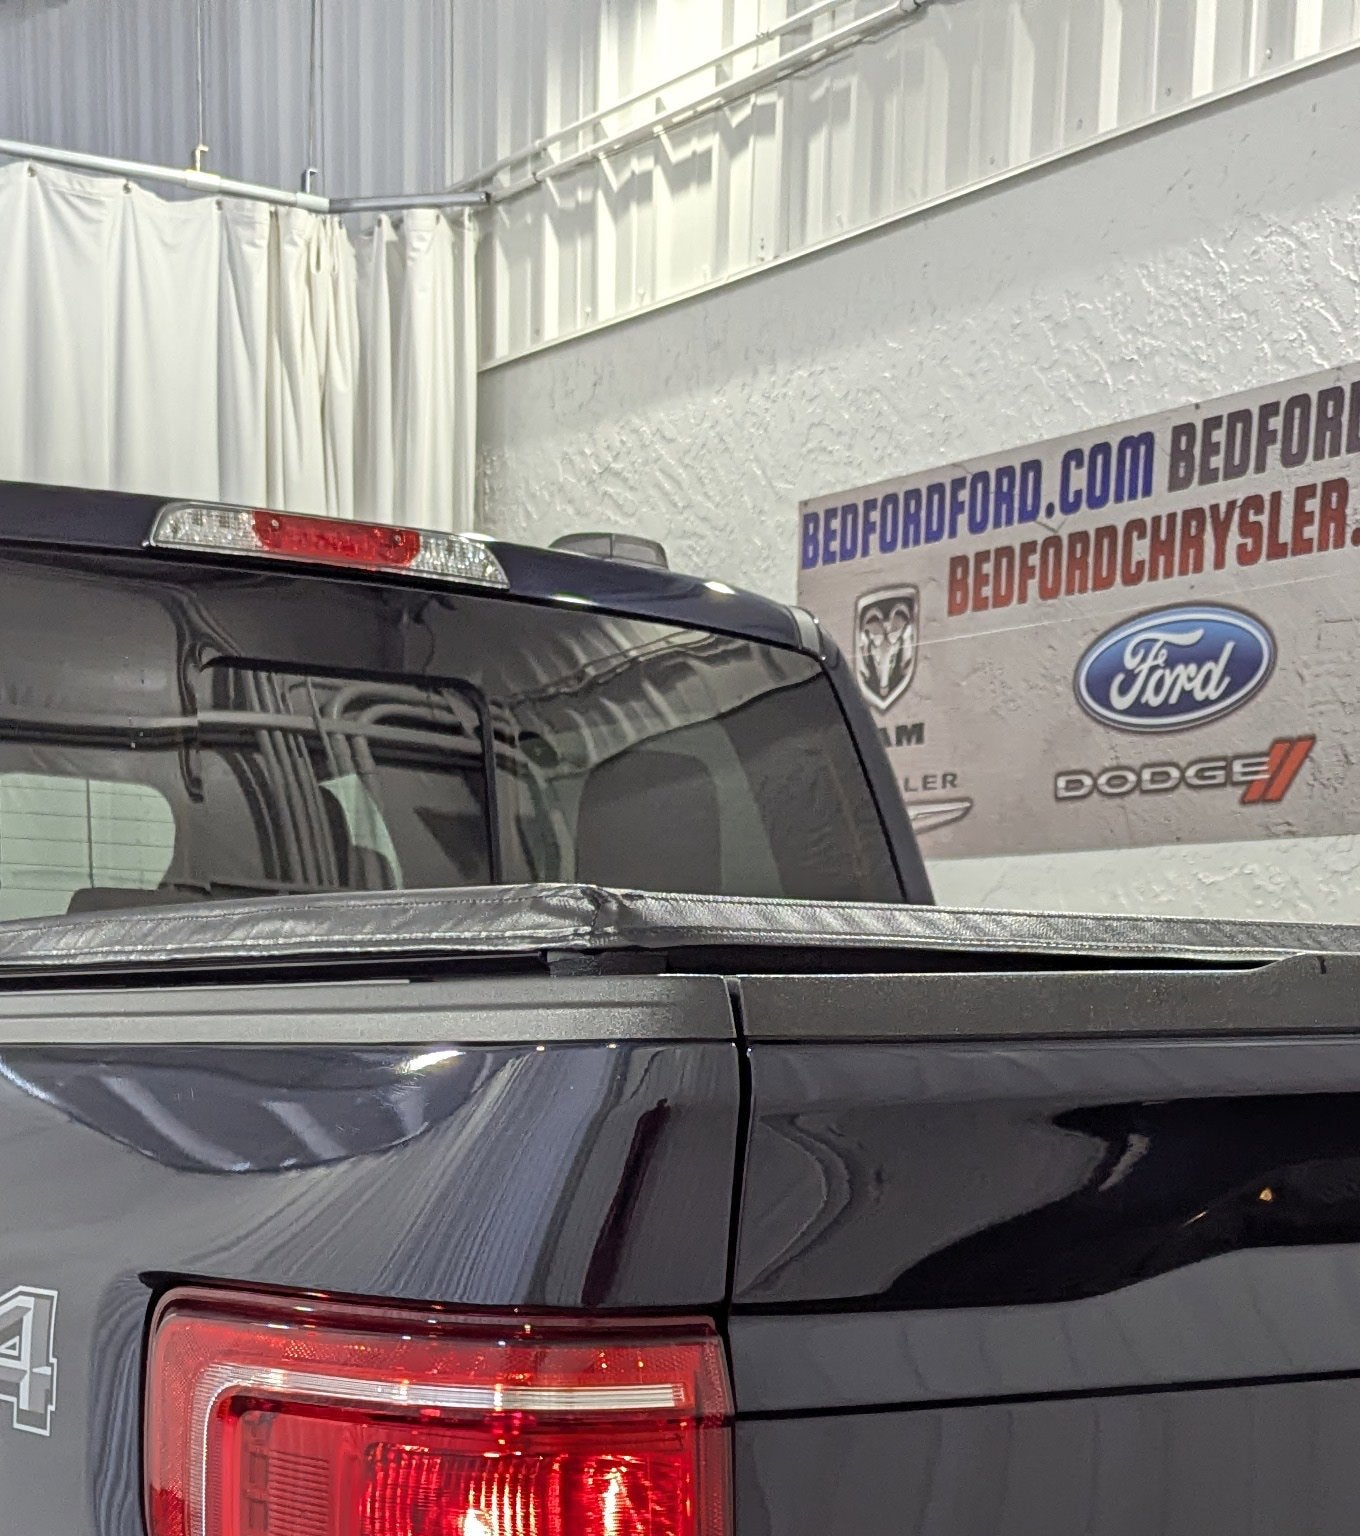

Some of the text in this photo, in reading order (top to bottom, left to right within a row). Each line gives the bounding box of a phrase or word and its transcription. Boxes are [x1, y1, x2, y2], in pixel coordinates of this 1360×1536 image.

[800, 430, 1155, 570] BEDFORDFORD.COM
[1109, 628, 1236, 711] Ford
[1054, 751, 1272, 801] DODGE
